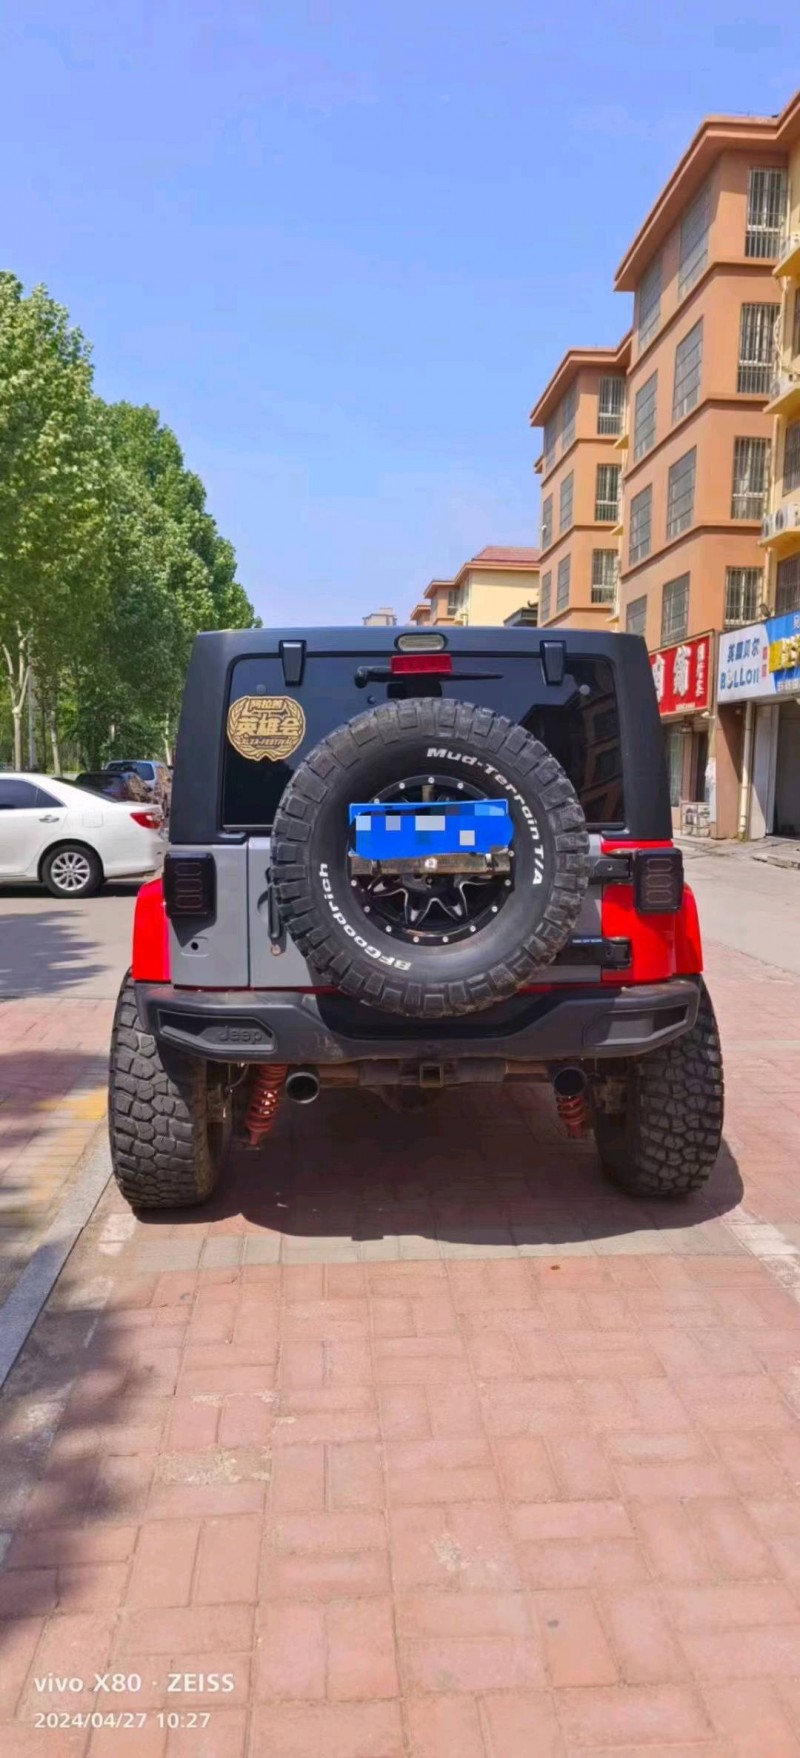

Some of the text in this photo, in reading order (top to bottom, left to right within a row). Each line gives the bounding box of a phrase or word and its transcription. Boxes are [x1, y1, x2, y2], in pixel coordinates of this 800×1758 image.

[236, 713, 300, 736] 英雄会
[426, 746, 544, 886] Mud-Terrain T/A
[318, 862, 412, 972] BFGoodrich
[217, 1025, 262, 1044] Jeep
